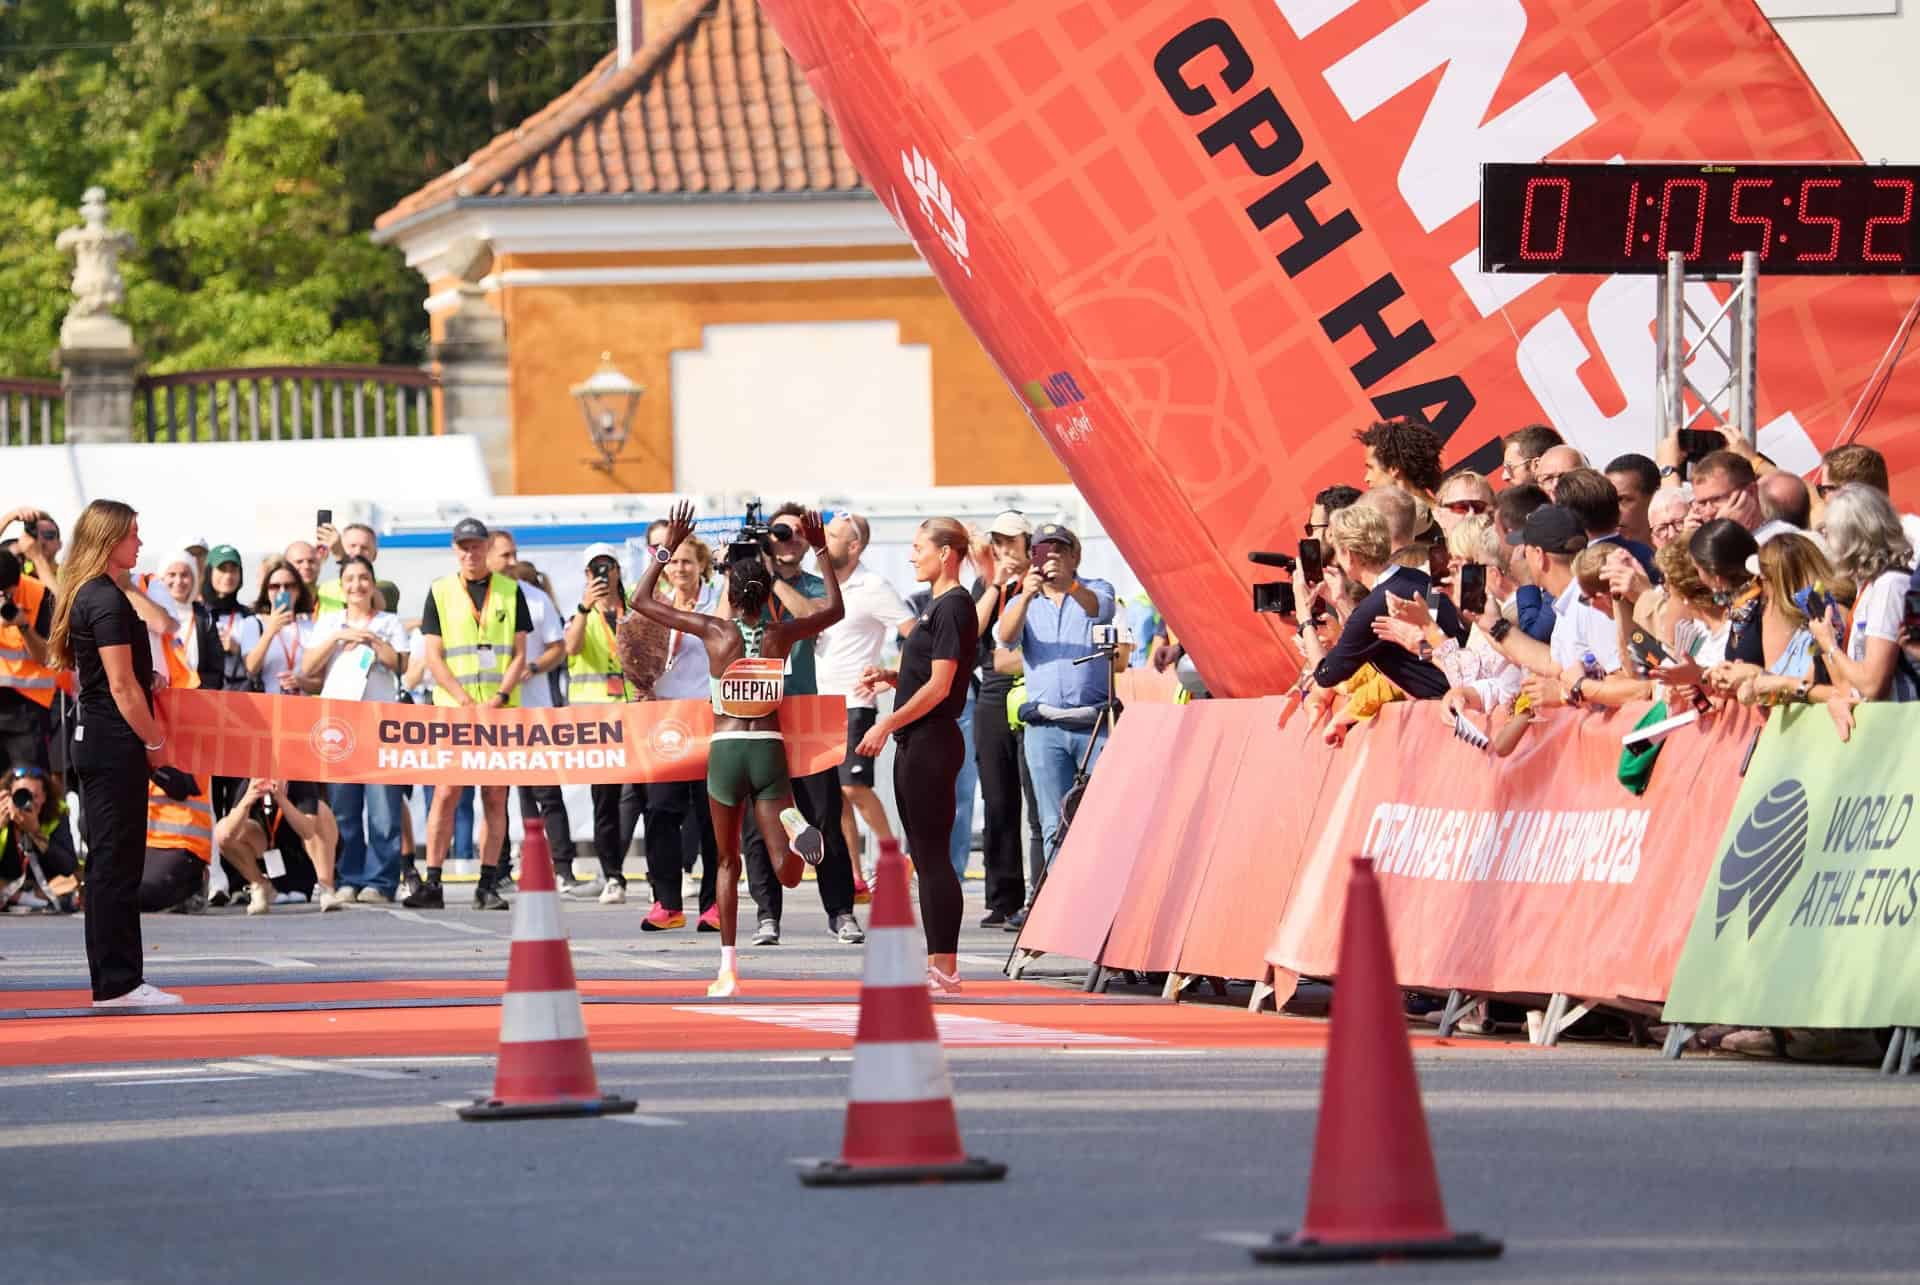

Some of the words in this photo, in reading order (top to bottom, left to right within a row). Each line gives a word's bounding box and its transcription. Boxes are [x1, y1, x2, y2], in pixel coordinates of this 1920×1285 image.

[1153, 17, 1363, 280] CPH
[1519, 178, 1571, 261] 0
[1624, 178, 1915, 262] 1:05:52
[722, 680, 779, 701] CHEPTAI
[377, 747, 450, 769] HALF
[461, 748, 627, 770] MARATHON
[378, 719, 625, 747] COPENHAGEN
[1821, 793, 1914, 853] WORLD
[1789, 867, 1920, 927] ATHLETICS
